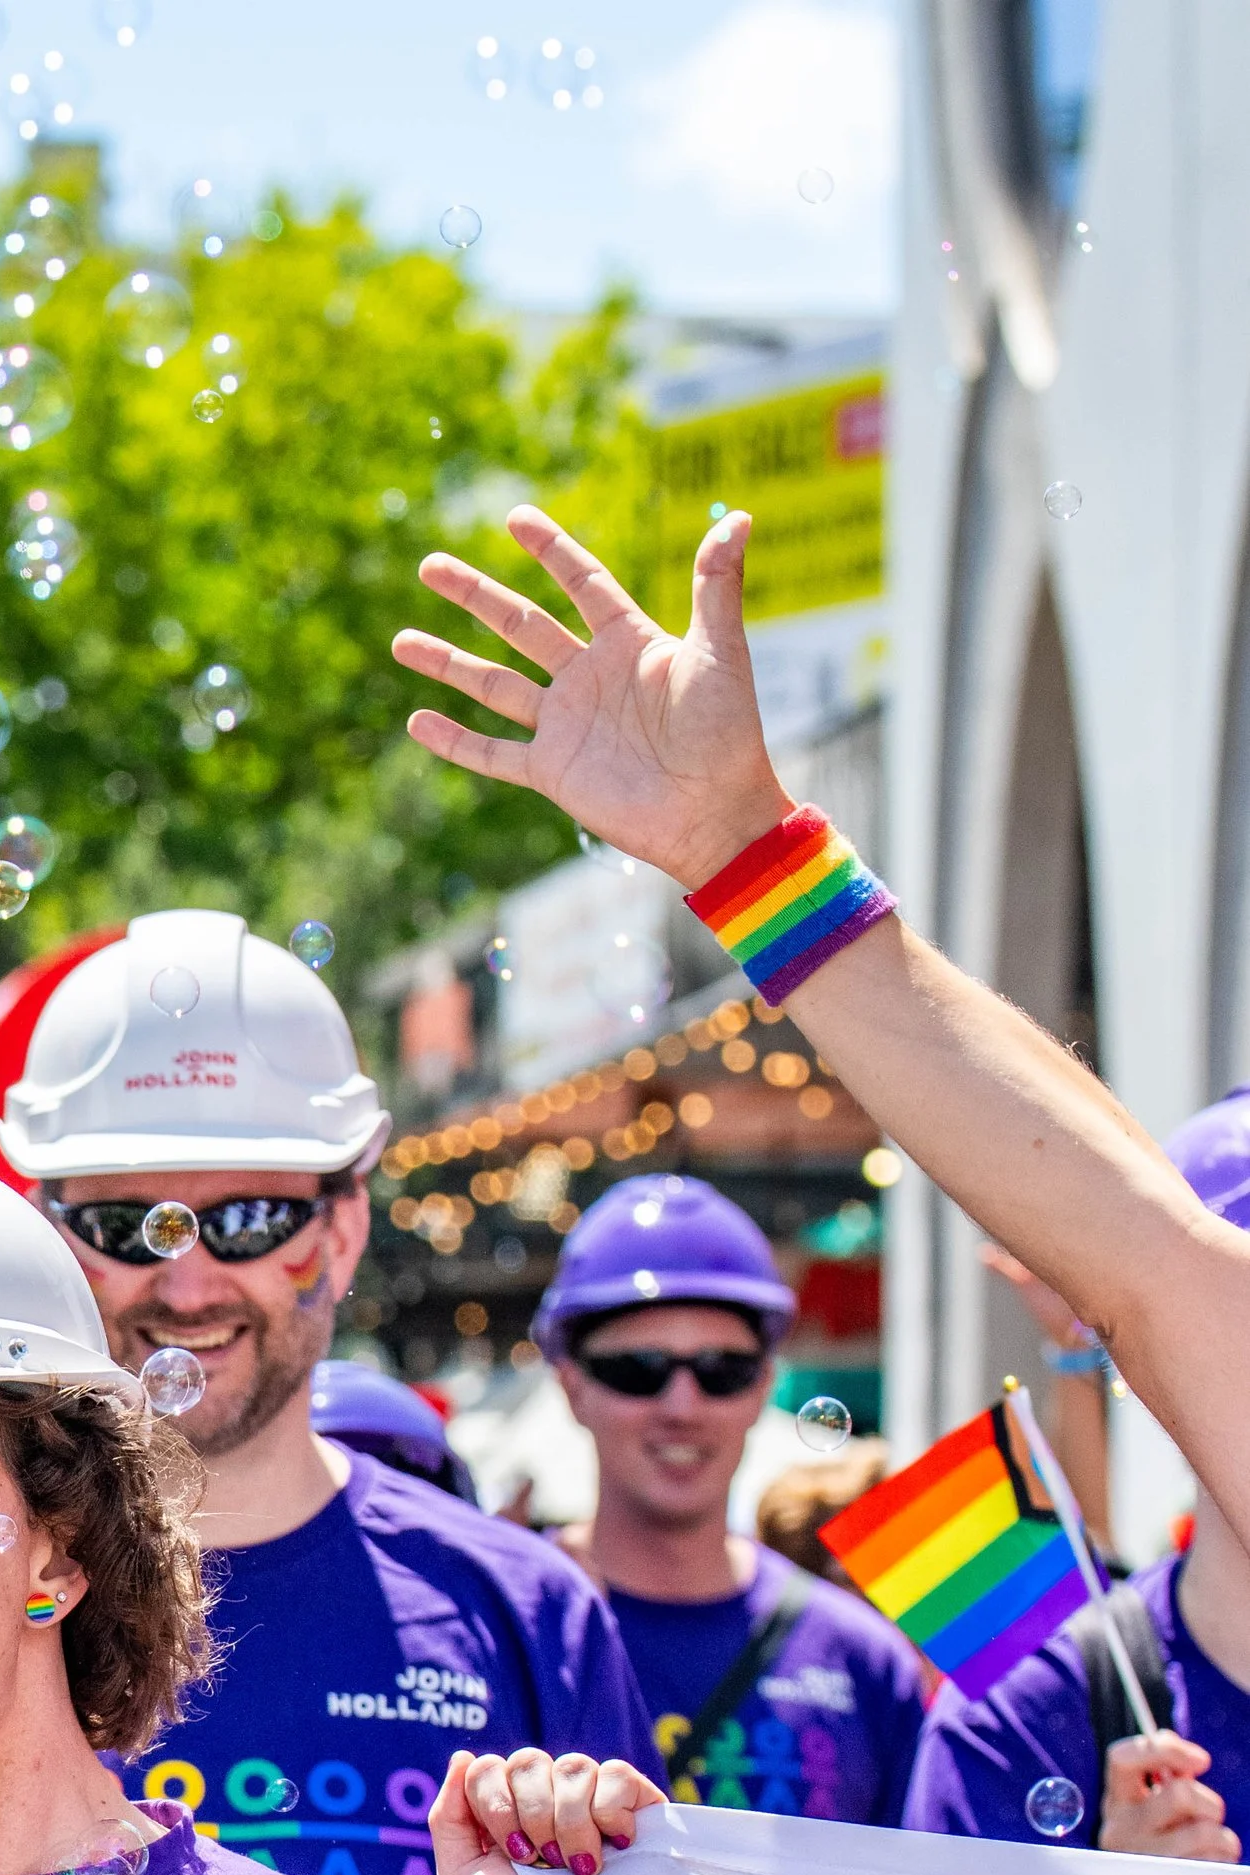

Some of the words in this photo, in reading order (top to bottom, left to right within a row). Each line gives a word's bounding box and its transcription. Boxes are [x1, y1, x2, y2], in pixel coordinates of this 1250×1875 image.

[173, 1050, 237, 1066] JOHN
[124, 1071, 237, 1091] HOLLAND
[396, 1665, 488, 1700] JOHN
[326, 1691, 488, 1730] HOLLAND
